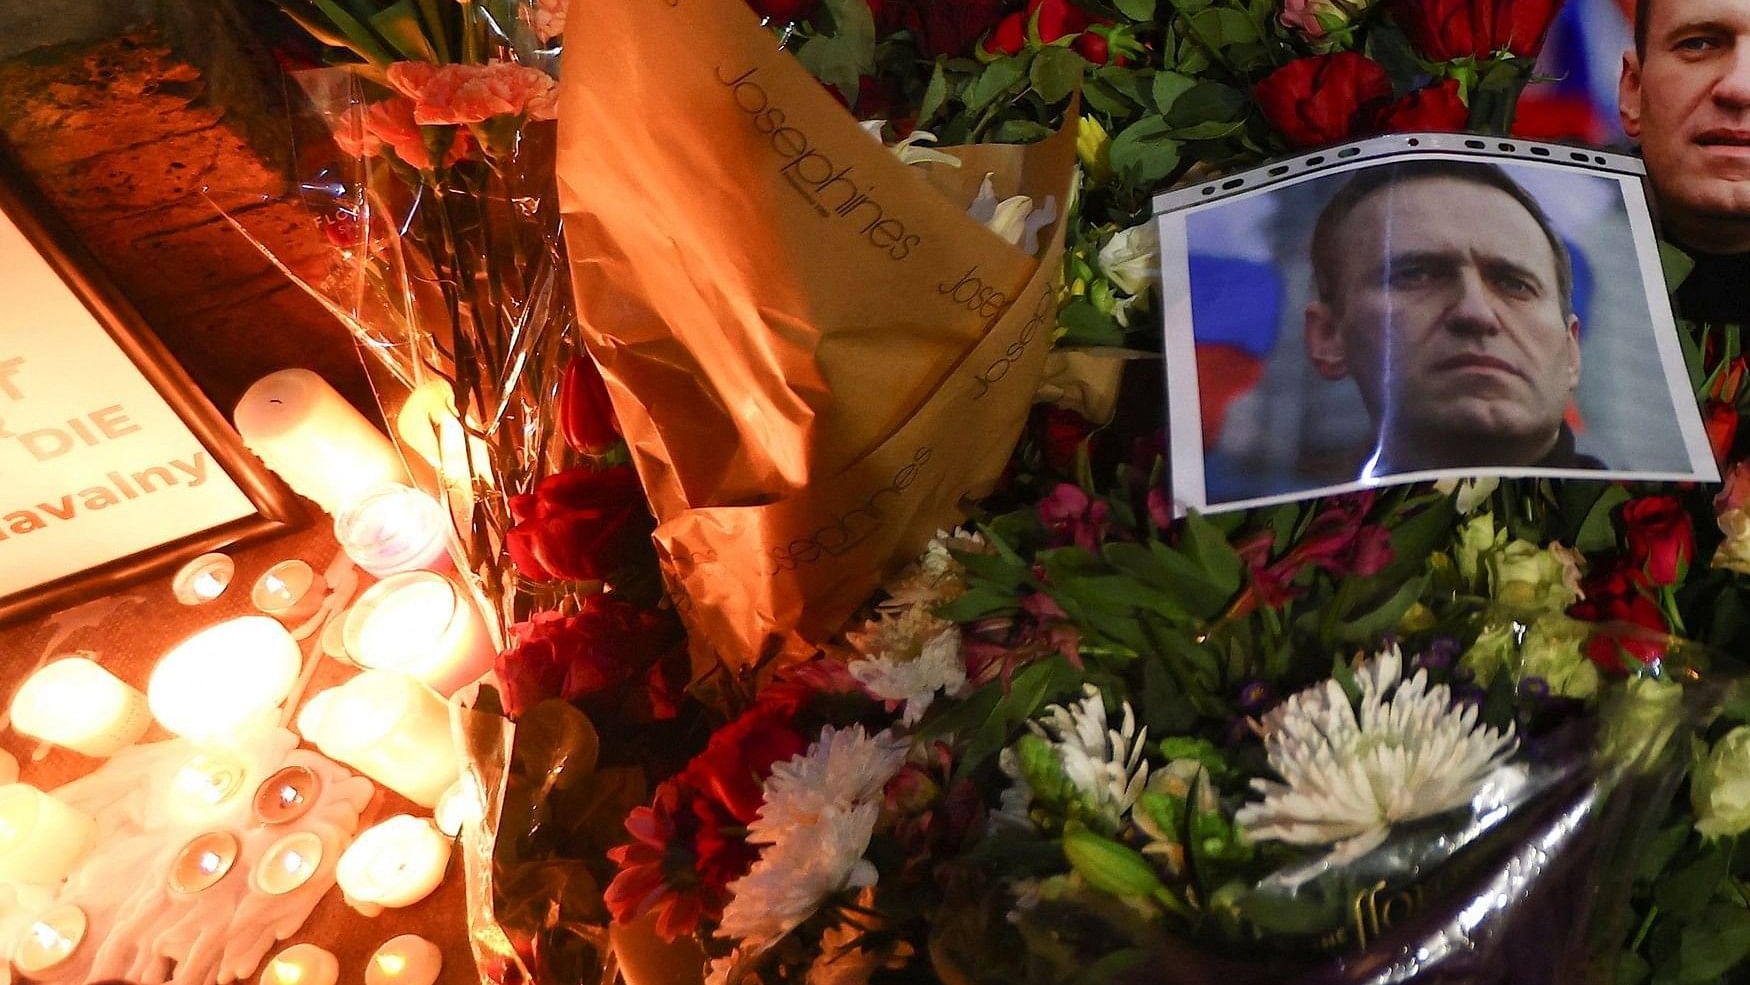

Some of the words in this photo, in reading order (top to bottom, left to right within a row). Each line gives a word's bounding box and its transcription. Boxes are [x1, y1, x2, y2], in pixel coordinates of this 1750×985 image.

[714, 65, 921, 260] Josephines
[17, 404, 143, 462] DIE
[0, 452, 204, 541] avalny
